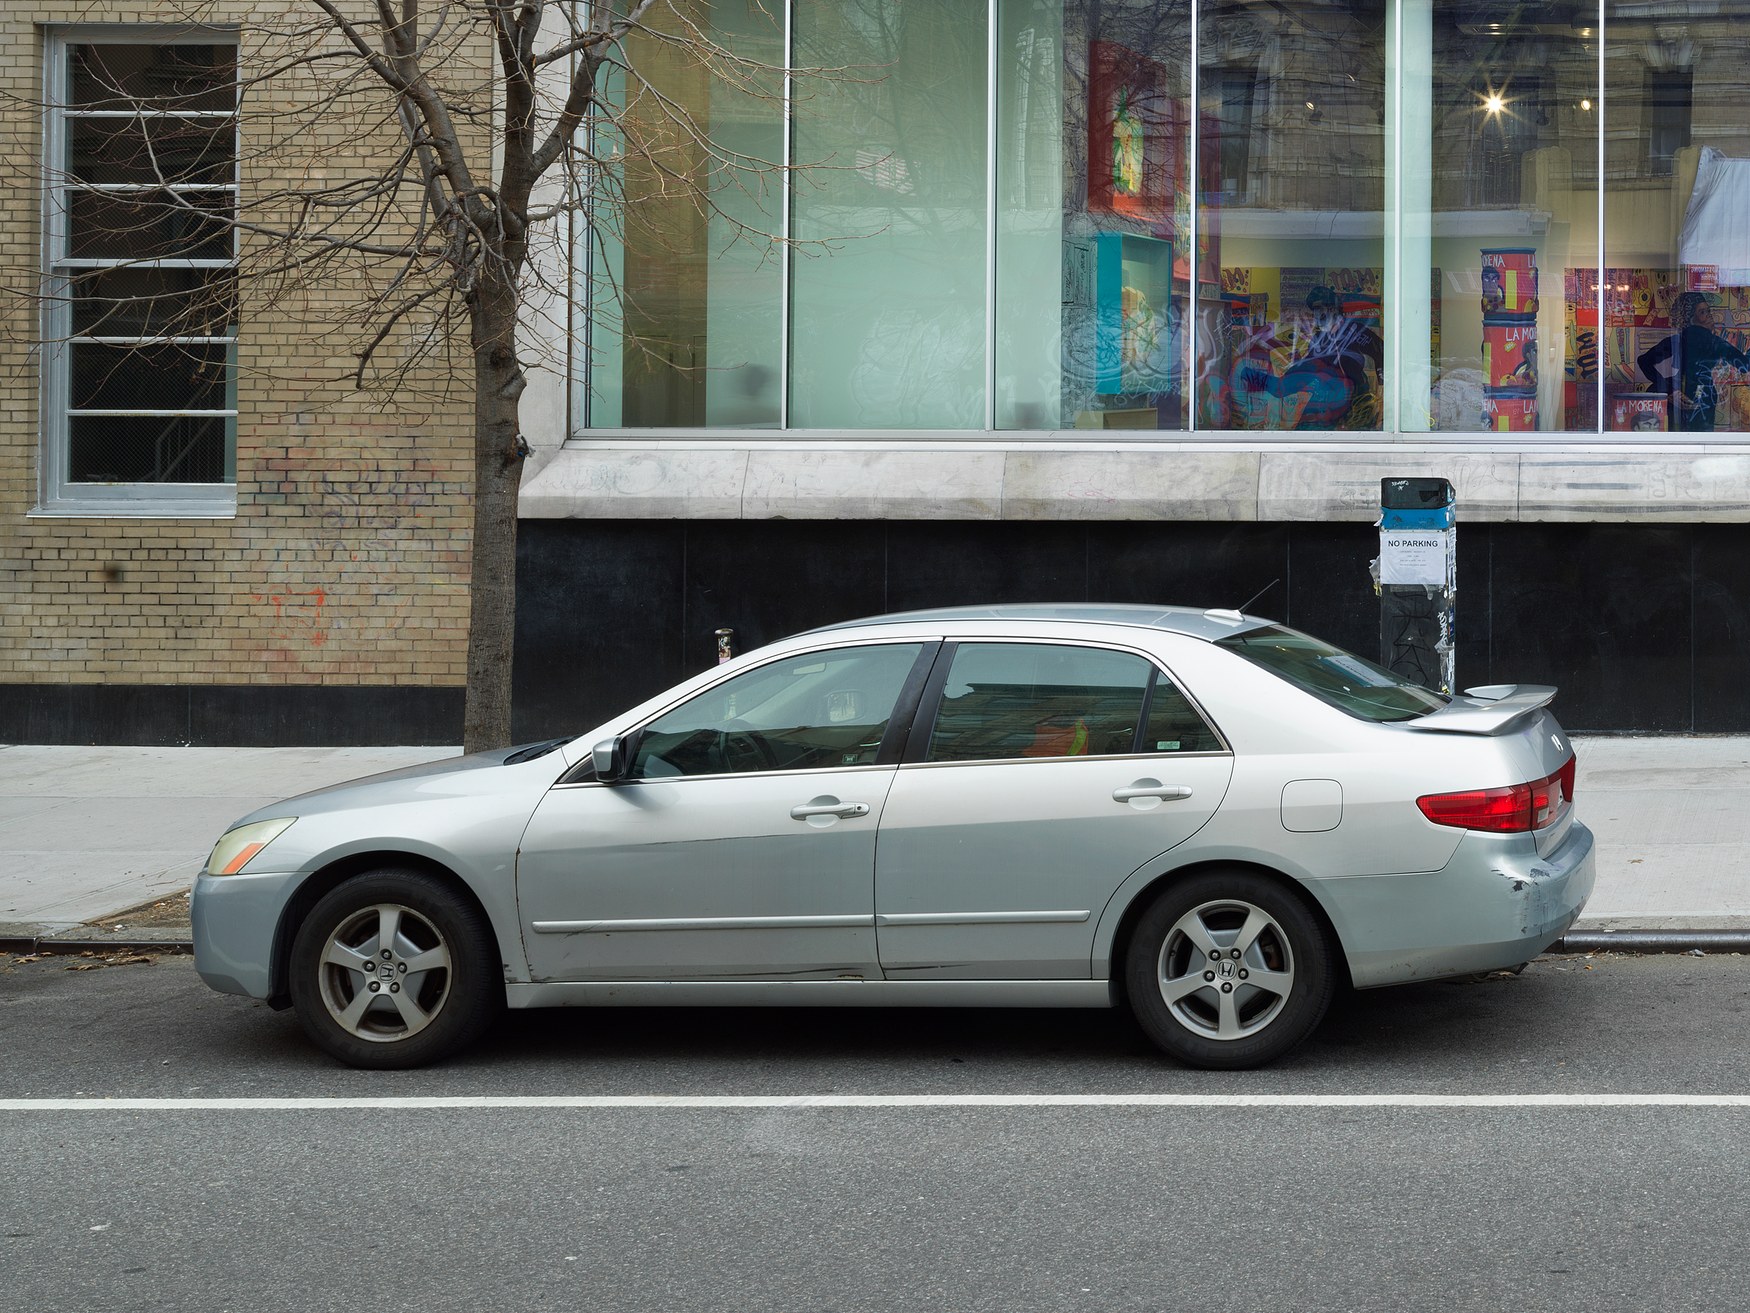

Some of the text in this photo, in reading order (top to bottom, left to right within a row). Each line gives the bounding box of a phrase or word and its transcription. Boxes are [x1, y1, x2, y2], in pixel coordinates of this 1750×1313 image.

[1617, 400, 1663, 413] LA MORENA
[1402, 540, 1439, 548] PARKING
